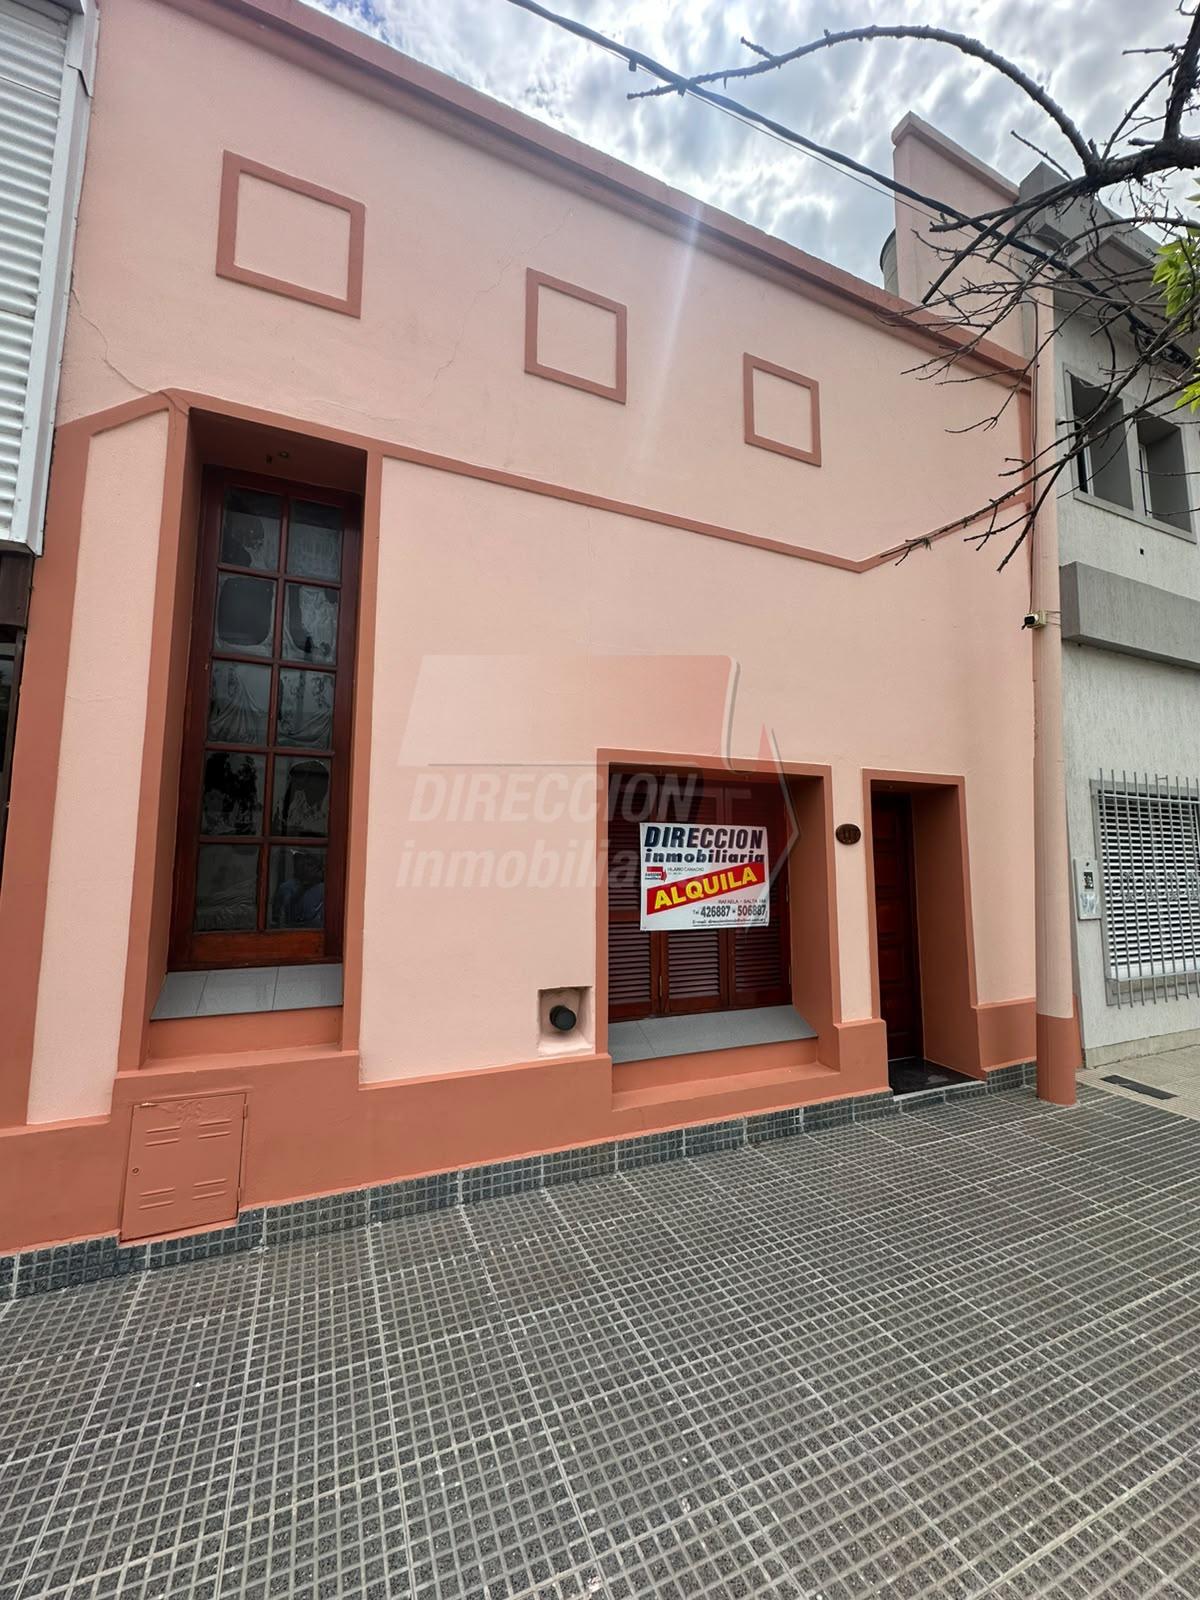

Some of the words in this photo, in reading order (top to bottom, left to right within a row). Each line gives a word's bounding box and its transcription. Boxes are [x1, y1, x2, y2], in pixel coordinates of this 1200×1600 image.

[645, 827, 763, 849] DIRECCION
[645, 848, 764, 863] inmobiliaria
[655, 866, 757, 909] ALQUILA
[700, 905, 730, 918] 426887
[737, 905, 766, 917] 506887
